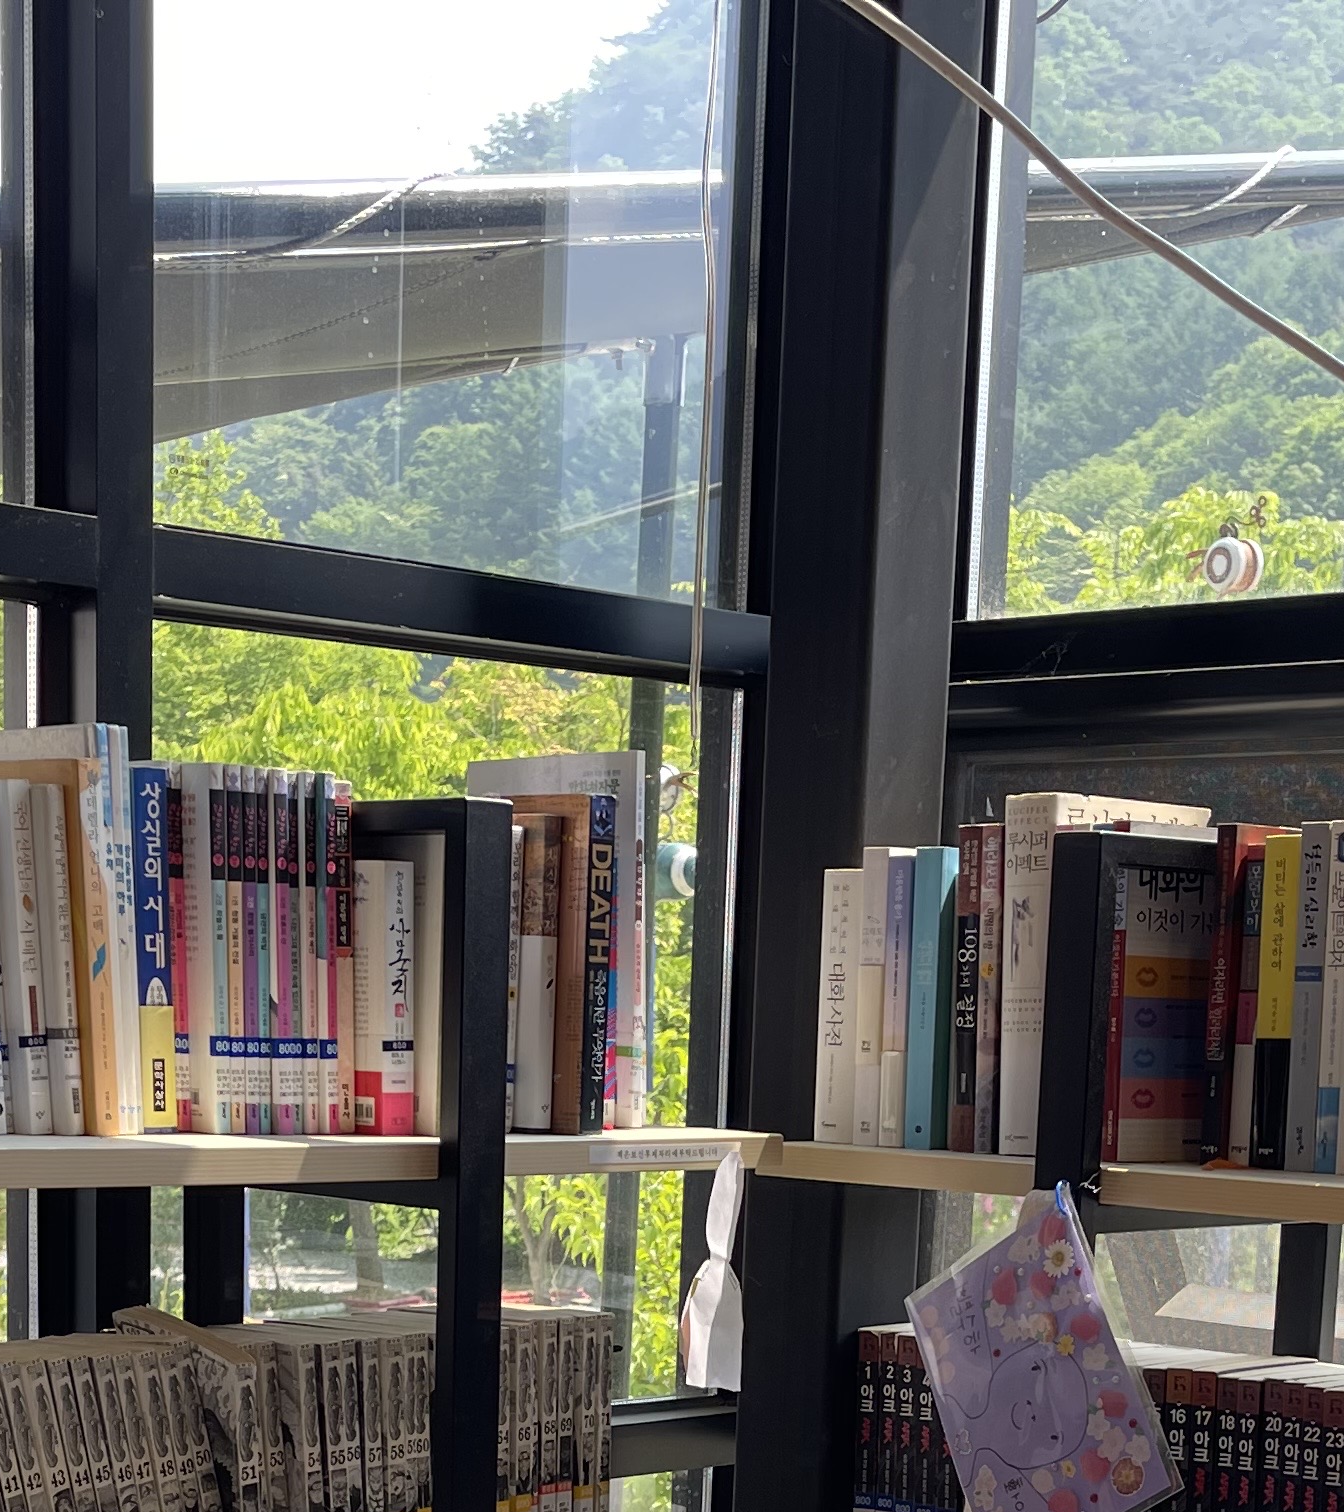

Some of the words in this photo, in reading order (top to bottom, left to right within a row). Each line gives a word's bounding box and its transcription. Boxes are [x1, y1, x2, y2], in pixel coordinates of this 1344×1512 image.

[140, 781, 162, 891] 상실의
[1007, 831, 1048, 850] 루시퍼
[1006, 855, 1049, 875] 이펙트
[589, 843, 612, 963] DEATH
[144, 895, 166, 969] 시대
[1136, 908, 1185, 934] 이것이
[864, 1366, 872, 1380] 1
[860, 1384, 875, 1413] 아크
[518, 1426, 531, 1441] 66
[1265, 1417, 1282, 1432] 20
[1325, 1432, 1344, 1448] 23
[1263, 1438, 1280, 1470] 아크
[160, 1459, 175, 1478] 48
[1325, 1454, 1342, 1486] 아크
